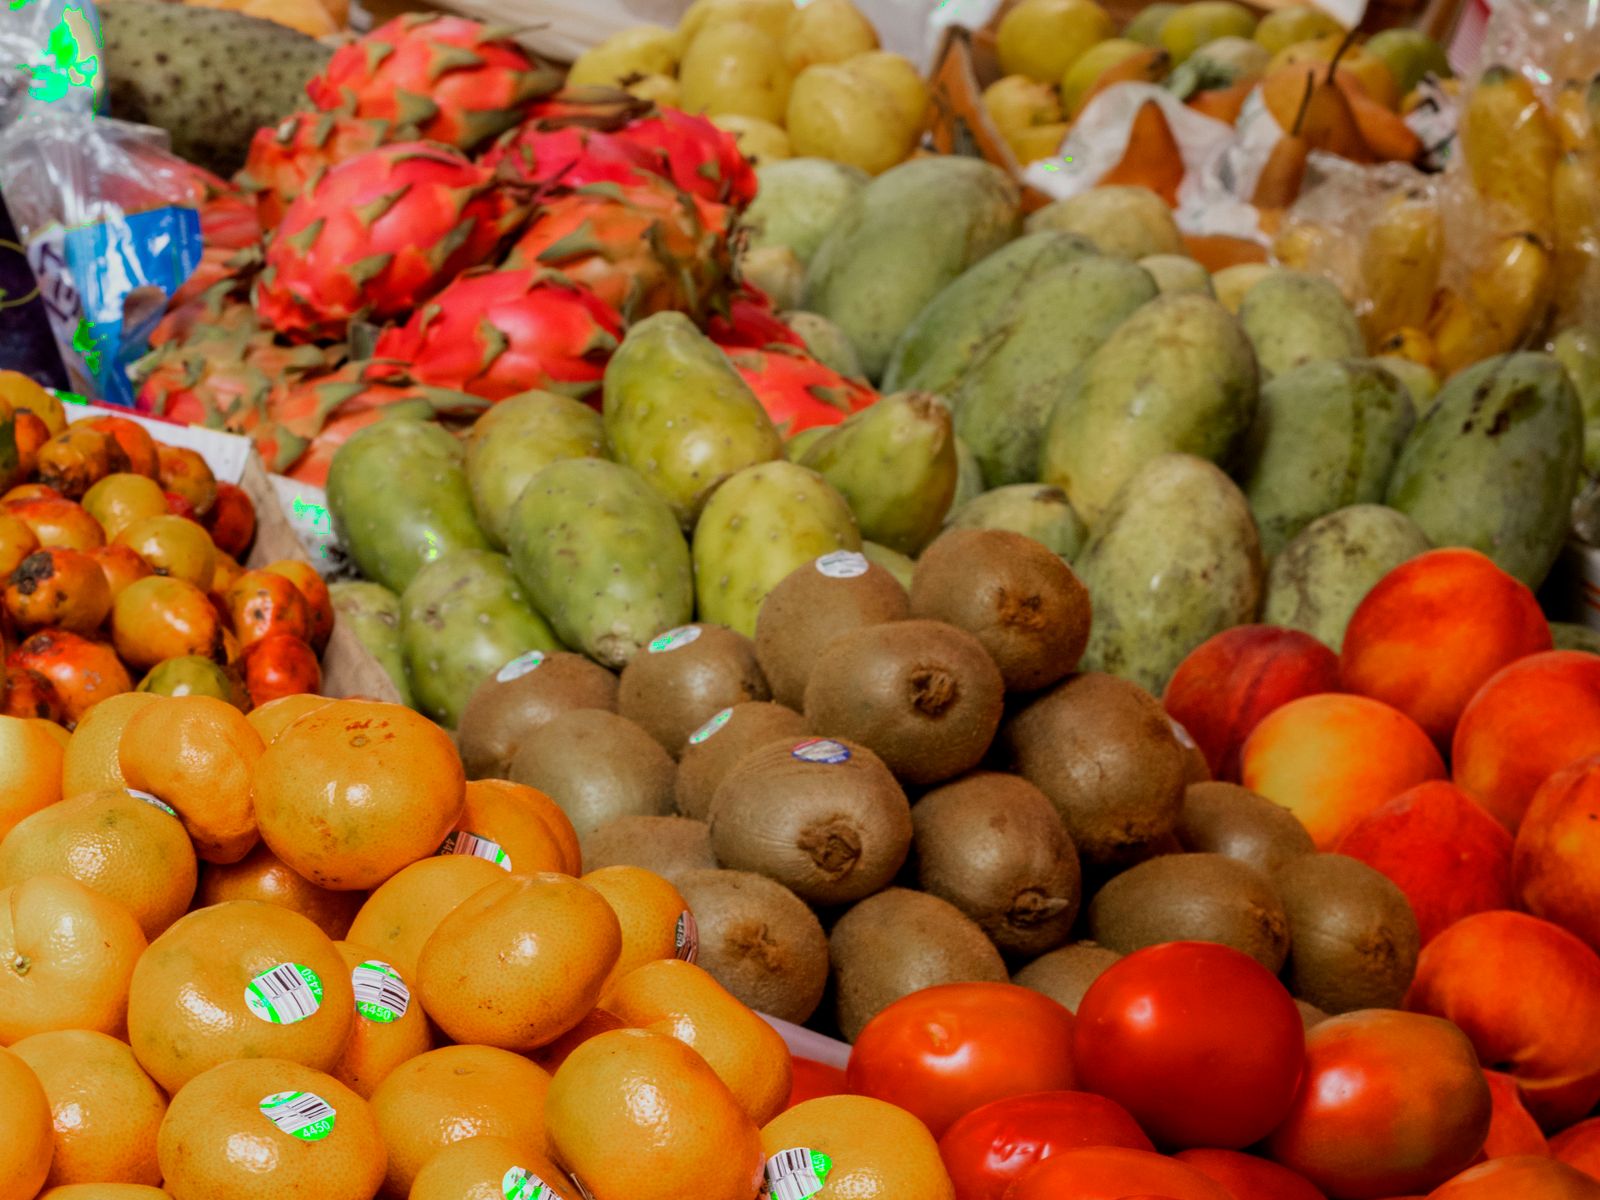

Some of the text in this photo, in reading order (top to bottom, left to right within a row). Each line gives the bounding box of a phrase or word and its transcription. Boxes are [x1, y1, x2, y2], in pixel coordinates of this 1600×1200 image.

[301, 968, 322, 995] 4450
[360, 1003, 391, 1020] 4450
[303, 1121, 330, 1137] 4450
